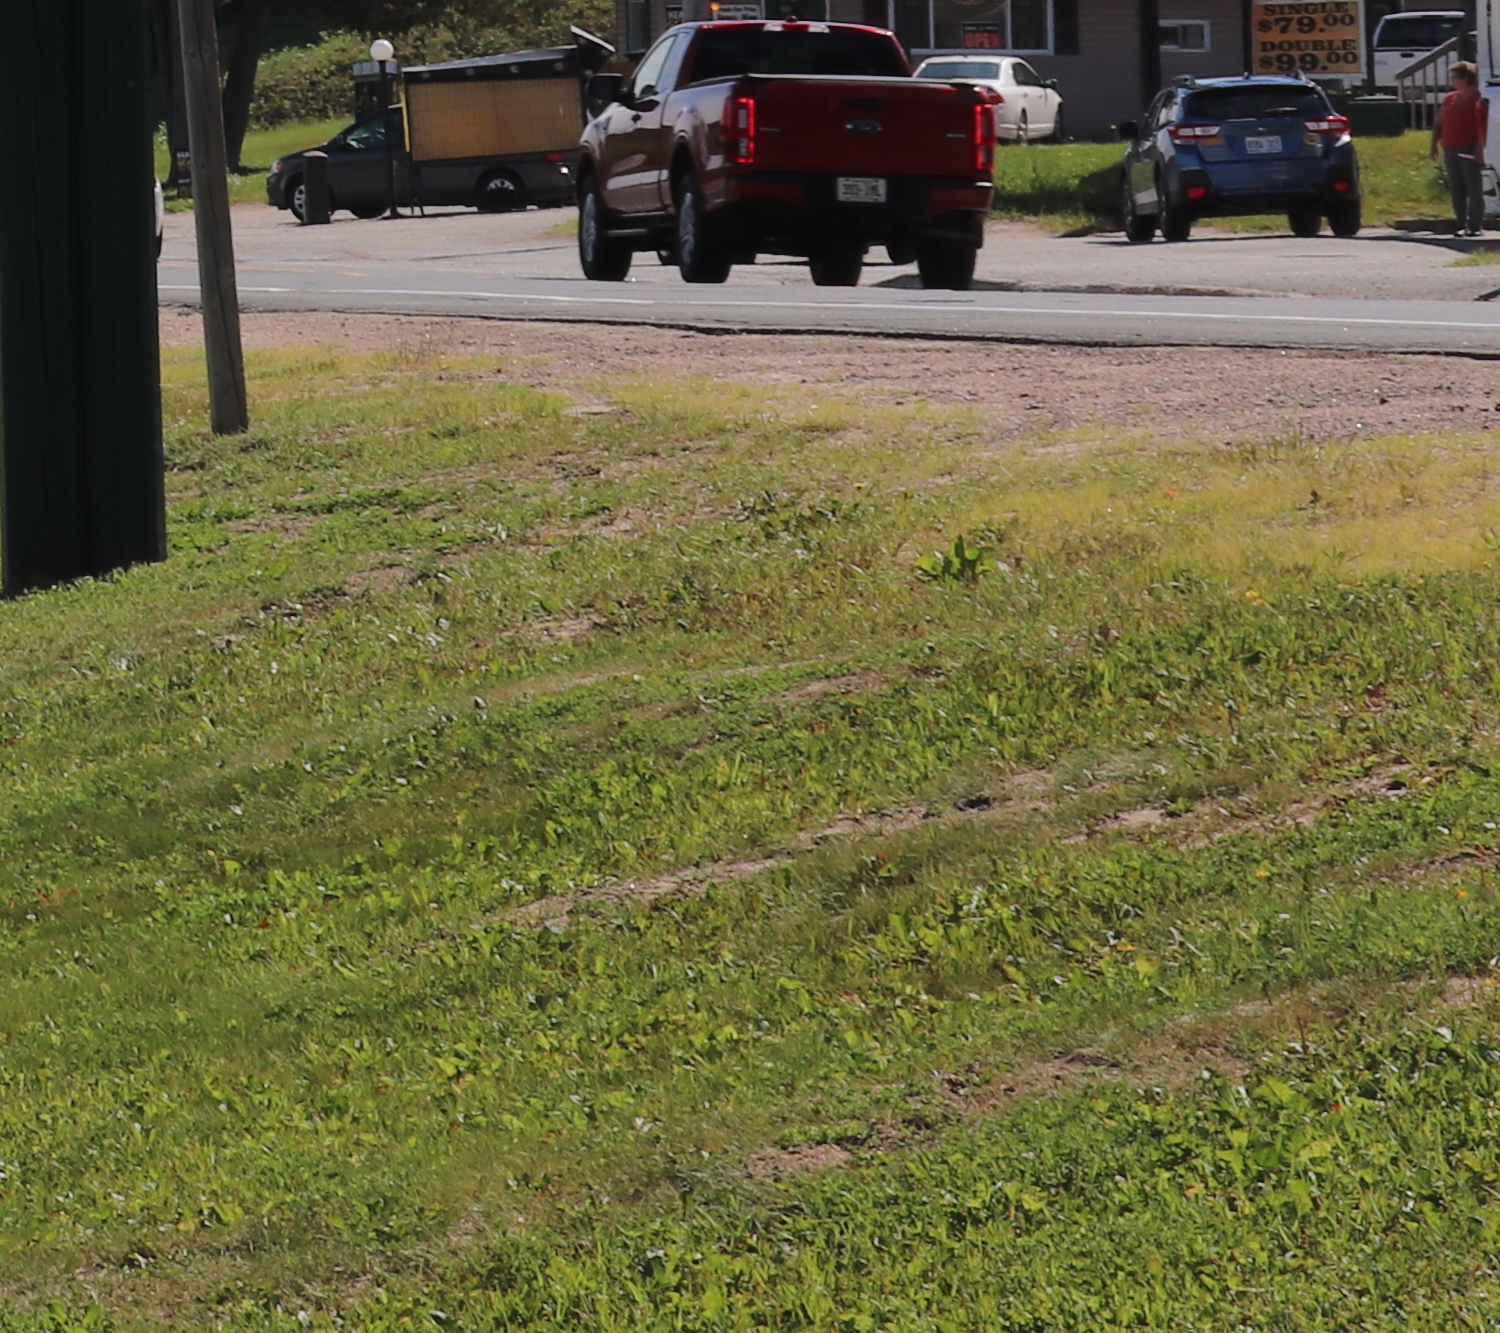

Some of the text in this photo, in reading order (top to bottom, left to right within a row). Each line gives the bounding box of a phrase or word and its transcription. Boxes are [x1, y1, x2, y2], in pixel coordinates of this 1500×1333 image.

[1263, 2, 1349, 15] SINGLE
[1257, 14, 1355, 34] $79.00
[1260, 39, 1357, 52] DOUBLE
[1258, 52, 1358, 71] $99.00
